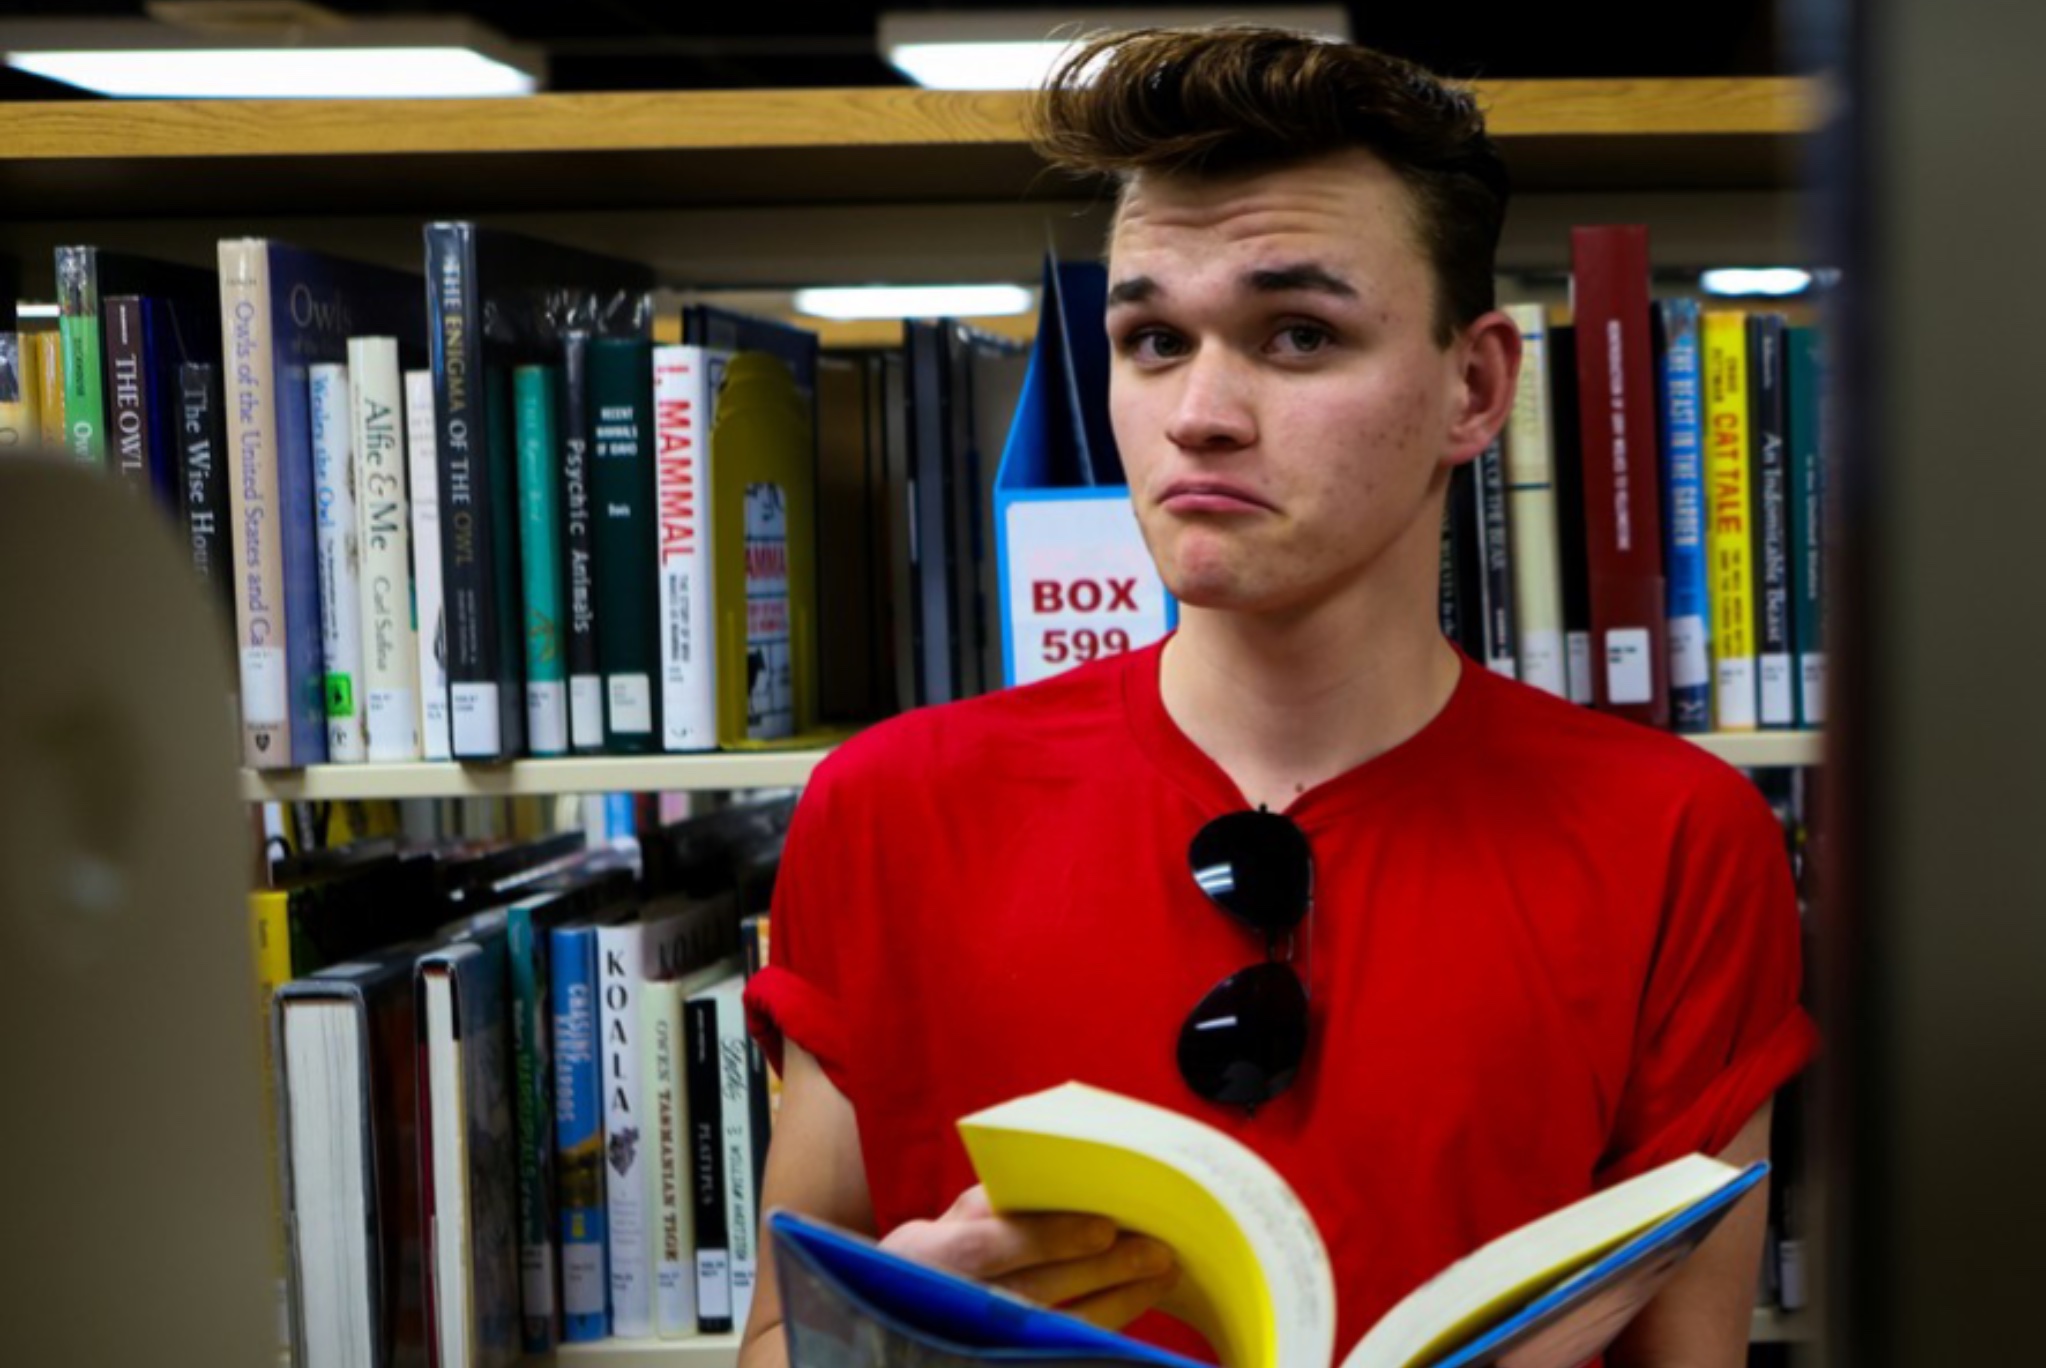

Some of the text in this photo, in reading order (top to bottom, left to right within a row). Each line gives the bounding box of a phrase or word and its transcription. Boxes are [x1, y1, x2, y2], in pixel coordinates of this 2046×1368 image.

[443, 255, 463, 306] THE
[235, 301, 255, 357] Owls
[238, 364, 257, 386] of
[445, 315, 466, 412] ENIGMA
[115, 353, 143, 476] THE OWL
[184, 385, 208, 433] The
[239, 392, 257, 423] the
[448, 418, 467, 451] OF
[188, 440, 211, 503] Wise
[240, 430, 262, 504] United
[365, 397, 398, 551] Alfie & Me
[1716, 412, 1743, 535] CAT TALE
[1763, 432, 1782, 464] An
[318, 487, 336, 527] Owl
[450, 457, 469, 504] THE
[658, 400, 695, 567] MAMMAL
[244, 507, 263, 567] States
[453, 512, 473, 566] OWL
[564, 438, 594, 633] Psychic Animals
[1764, 468, 1785, 583] Indomitable
[247, 573, 267, 611] and
[1032, 578, 1138, 614] BOX
[1766, 587, 1786, 642] Beast
[1042, 628, 1130, 664] 599
[606, 950, 630, 1113] KOALA
[658, 1090, 676, 1208] TASMANIAN
